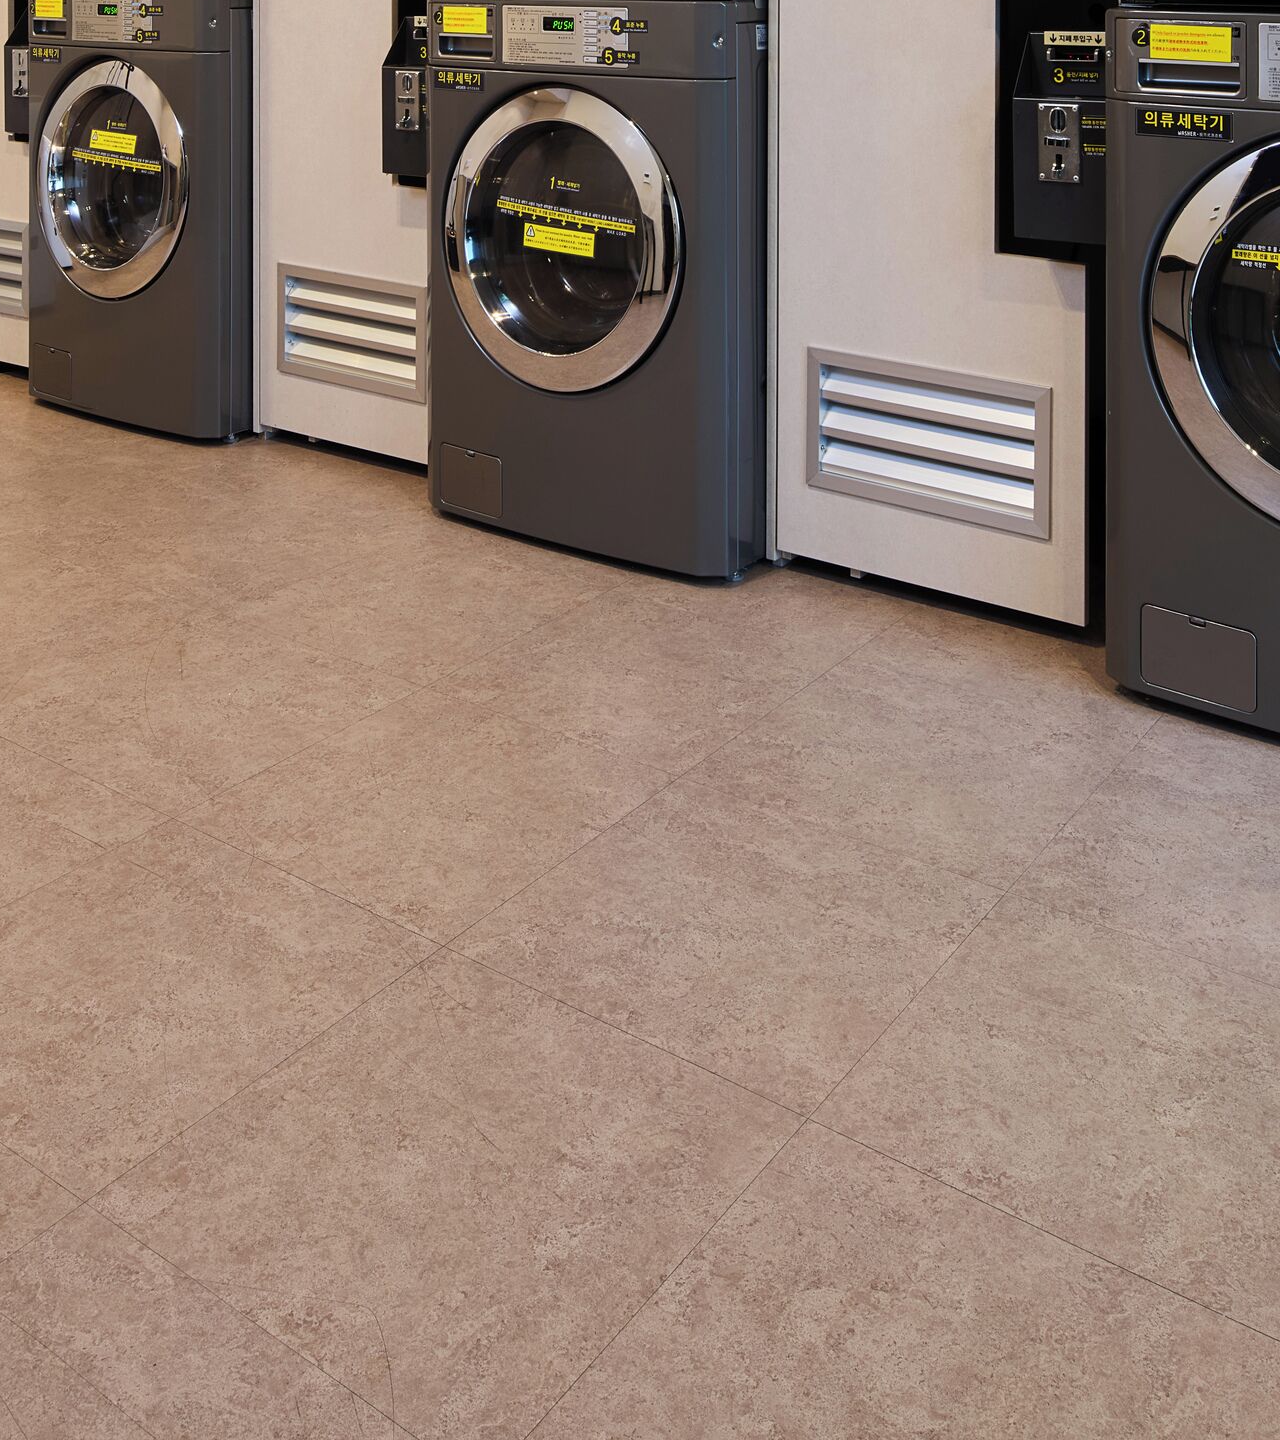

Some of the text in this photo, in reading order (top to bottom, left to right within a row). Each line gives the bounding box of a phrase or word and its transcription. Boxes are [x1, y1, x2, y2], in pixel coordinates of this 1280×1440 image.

[139, 4, 146, 16] 4
[436, 12, 443, 23] 2
[552, 20, 574, 30] PUSH
[137, 30, 143, 42] 5
[1137, 29, 1146, 45] 2
[32, 48, 60, 58] 의류세탁기
[419, 46, 427, 59] 3
[437, 71, 482, 86] 의류세탁기
[106, 119, 111, 130] 1
[1144, 111, 1224, 132] 의류세탁기
[550, 176, 555, 190] 1
